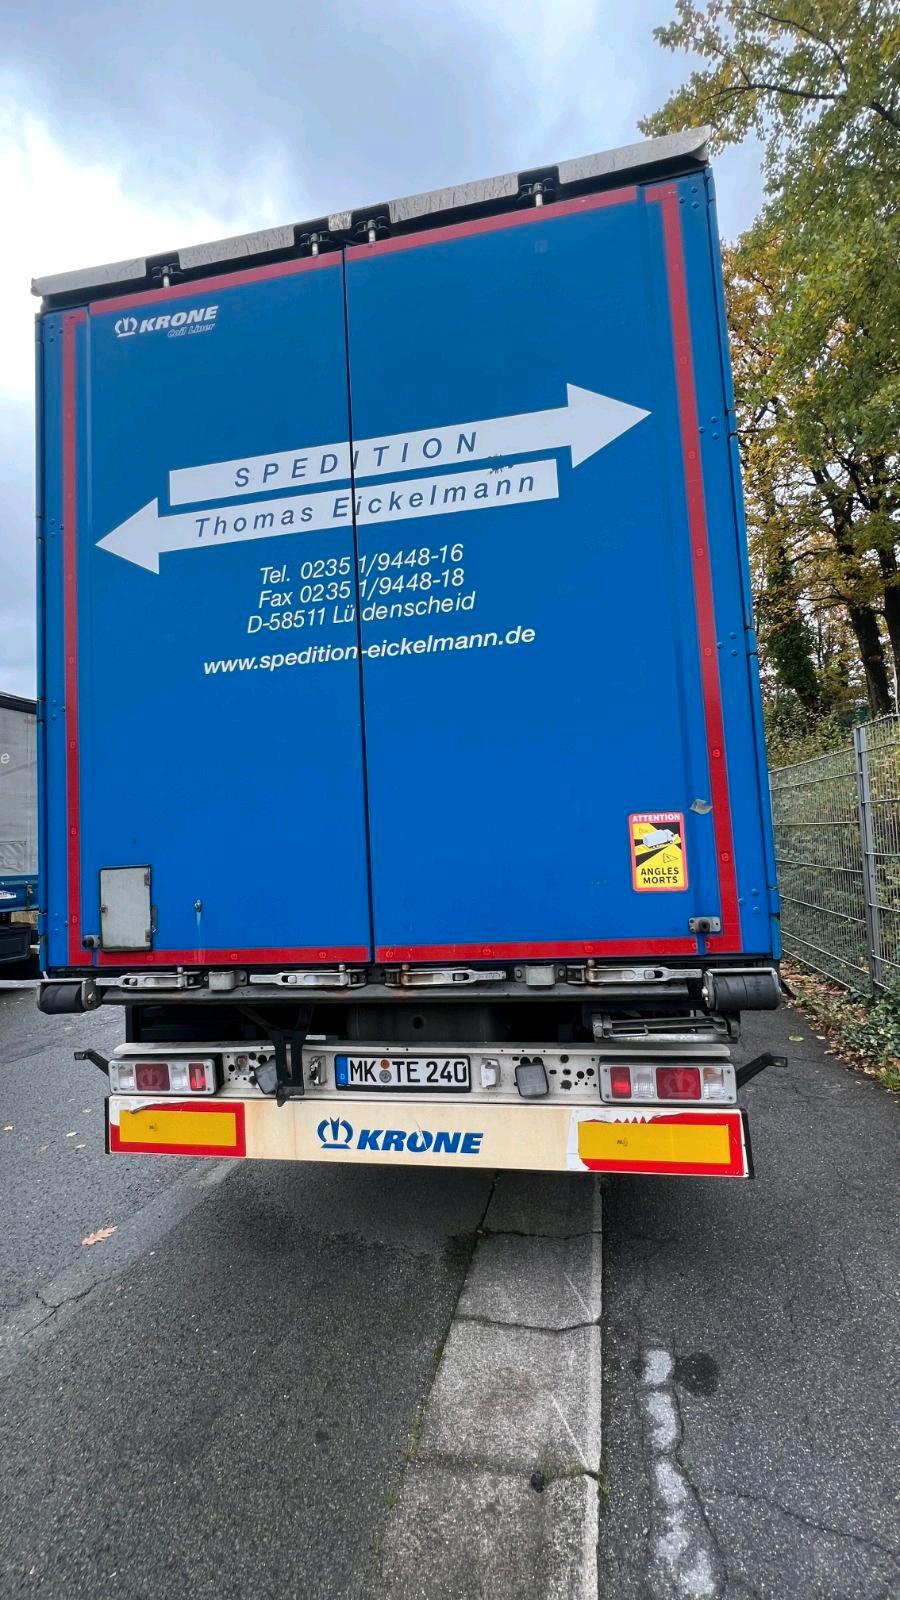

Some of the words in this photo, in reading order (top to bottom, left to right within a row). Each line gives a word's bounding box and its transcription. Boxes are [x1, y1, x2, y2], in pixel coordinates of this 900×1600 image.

[139, 305, 219, 333] KRONE
[234, 431, 478, 488] SPEDITION
[194, 506, 314, 538] Thomas
[332, 475, 535, 519] Eickelmann
[259, 564, 291, 585] Tel.
[258, 590, 294, 609] Fax
[247, 607, 327, 634] D-58511
[203, 625, 536, 675] www.spedition-eickelmann.de
[632, 813, 681, 822] ATTENTION
[640, 867, 680, 876] ANGLES
[643, 875, 679, 884] MORTS
[350, 1060, 377, 1083] MK
[391, 1060, 418, 1083] TE
[426, 1061, 467, 1083] 240
[356, 1129, 484, 1154] KRONE
